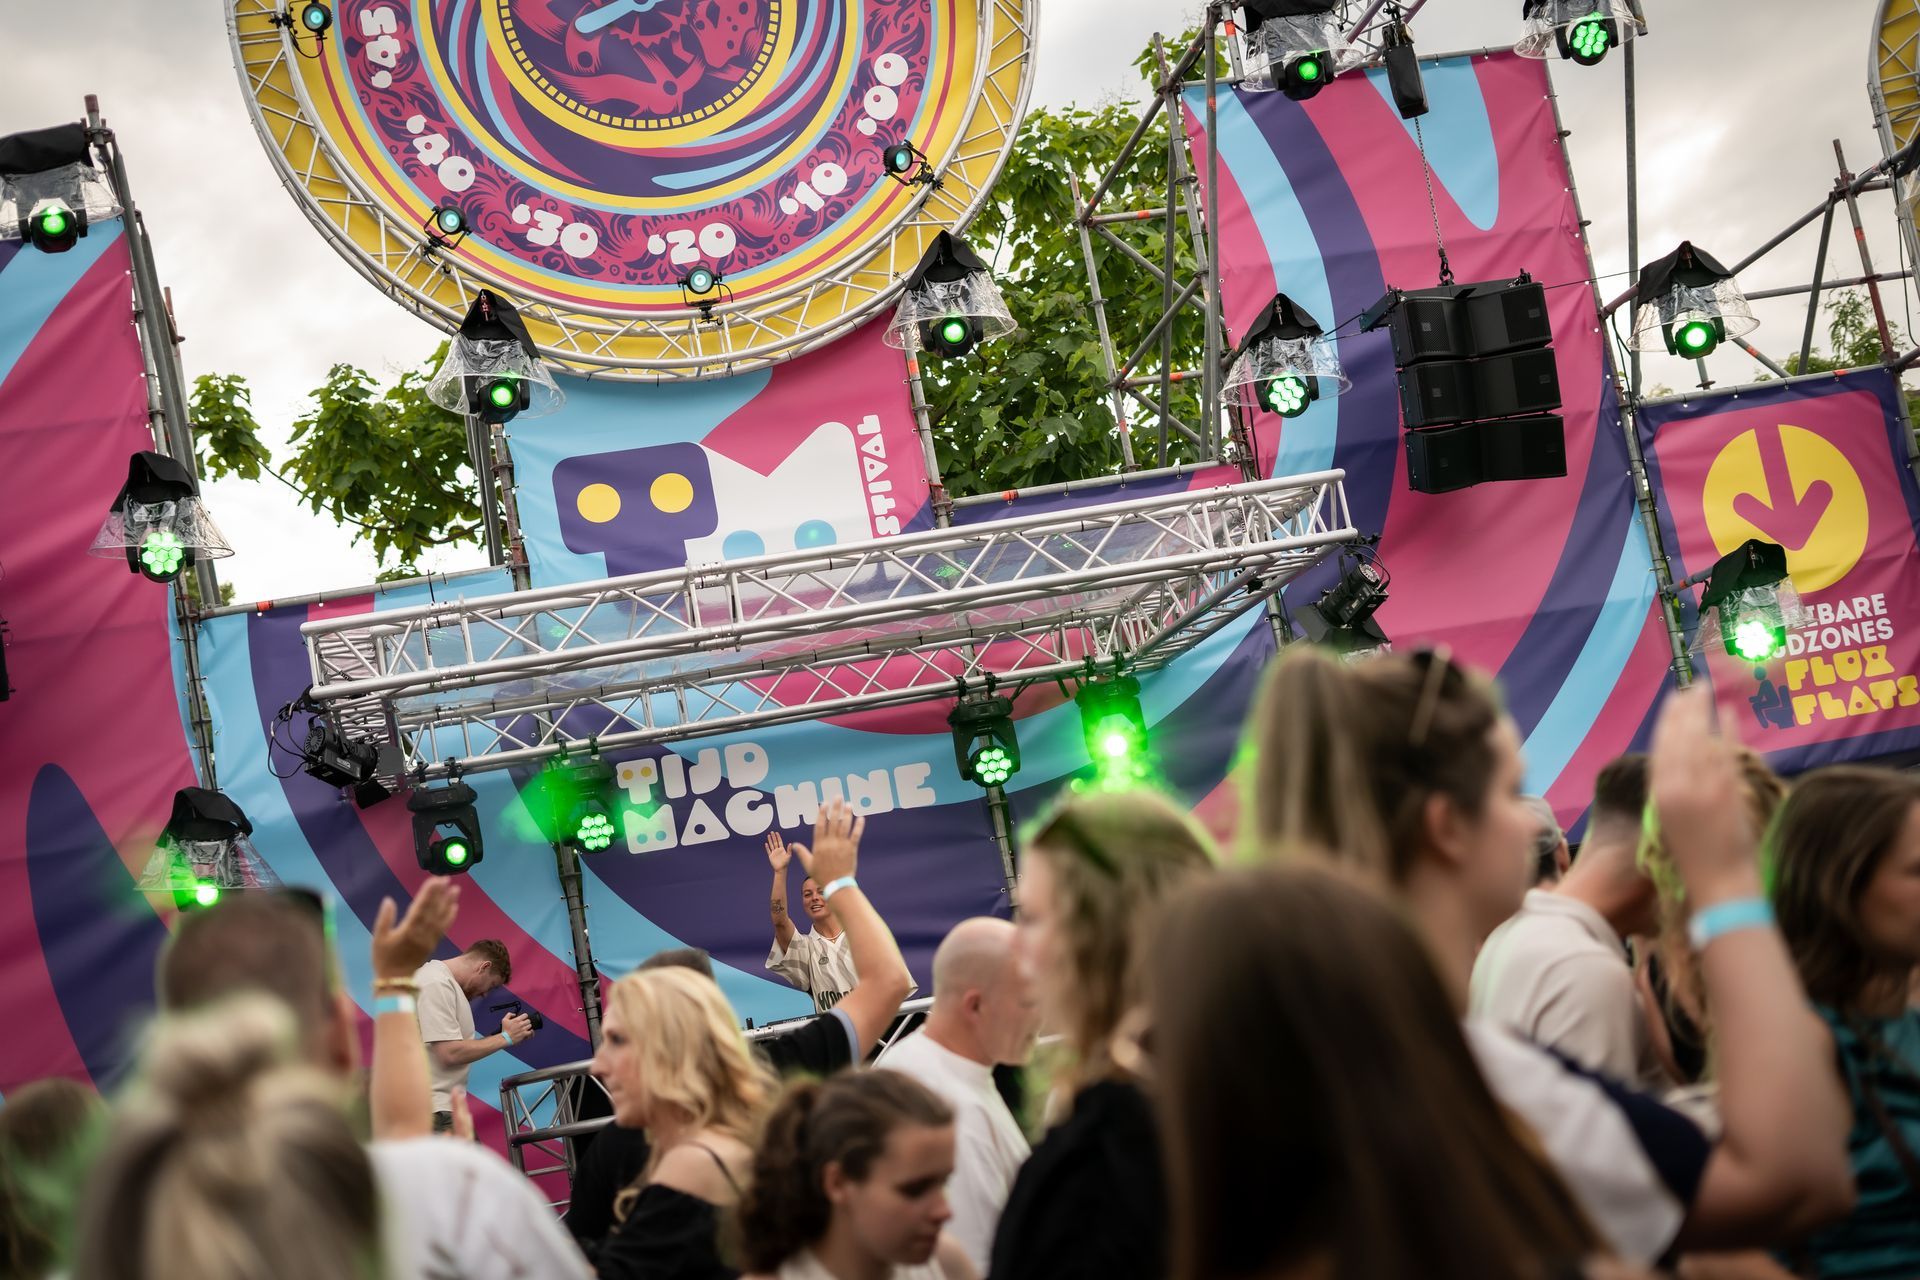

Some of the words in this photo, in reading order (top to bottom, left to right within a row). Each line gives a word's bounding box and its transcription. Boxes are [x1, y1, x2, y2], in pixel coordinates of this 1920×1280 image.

[857, 414, 901, 535] STIVAL
[1786, 645, 1895, 691] FLUX
[1793, 675, 1920, 726] FLATS
[616, 743, 769, 804] TIJD
[623, 762, 936, 854] MACHINE
